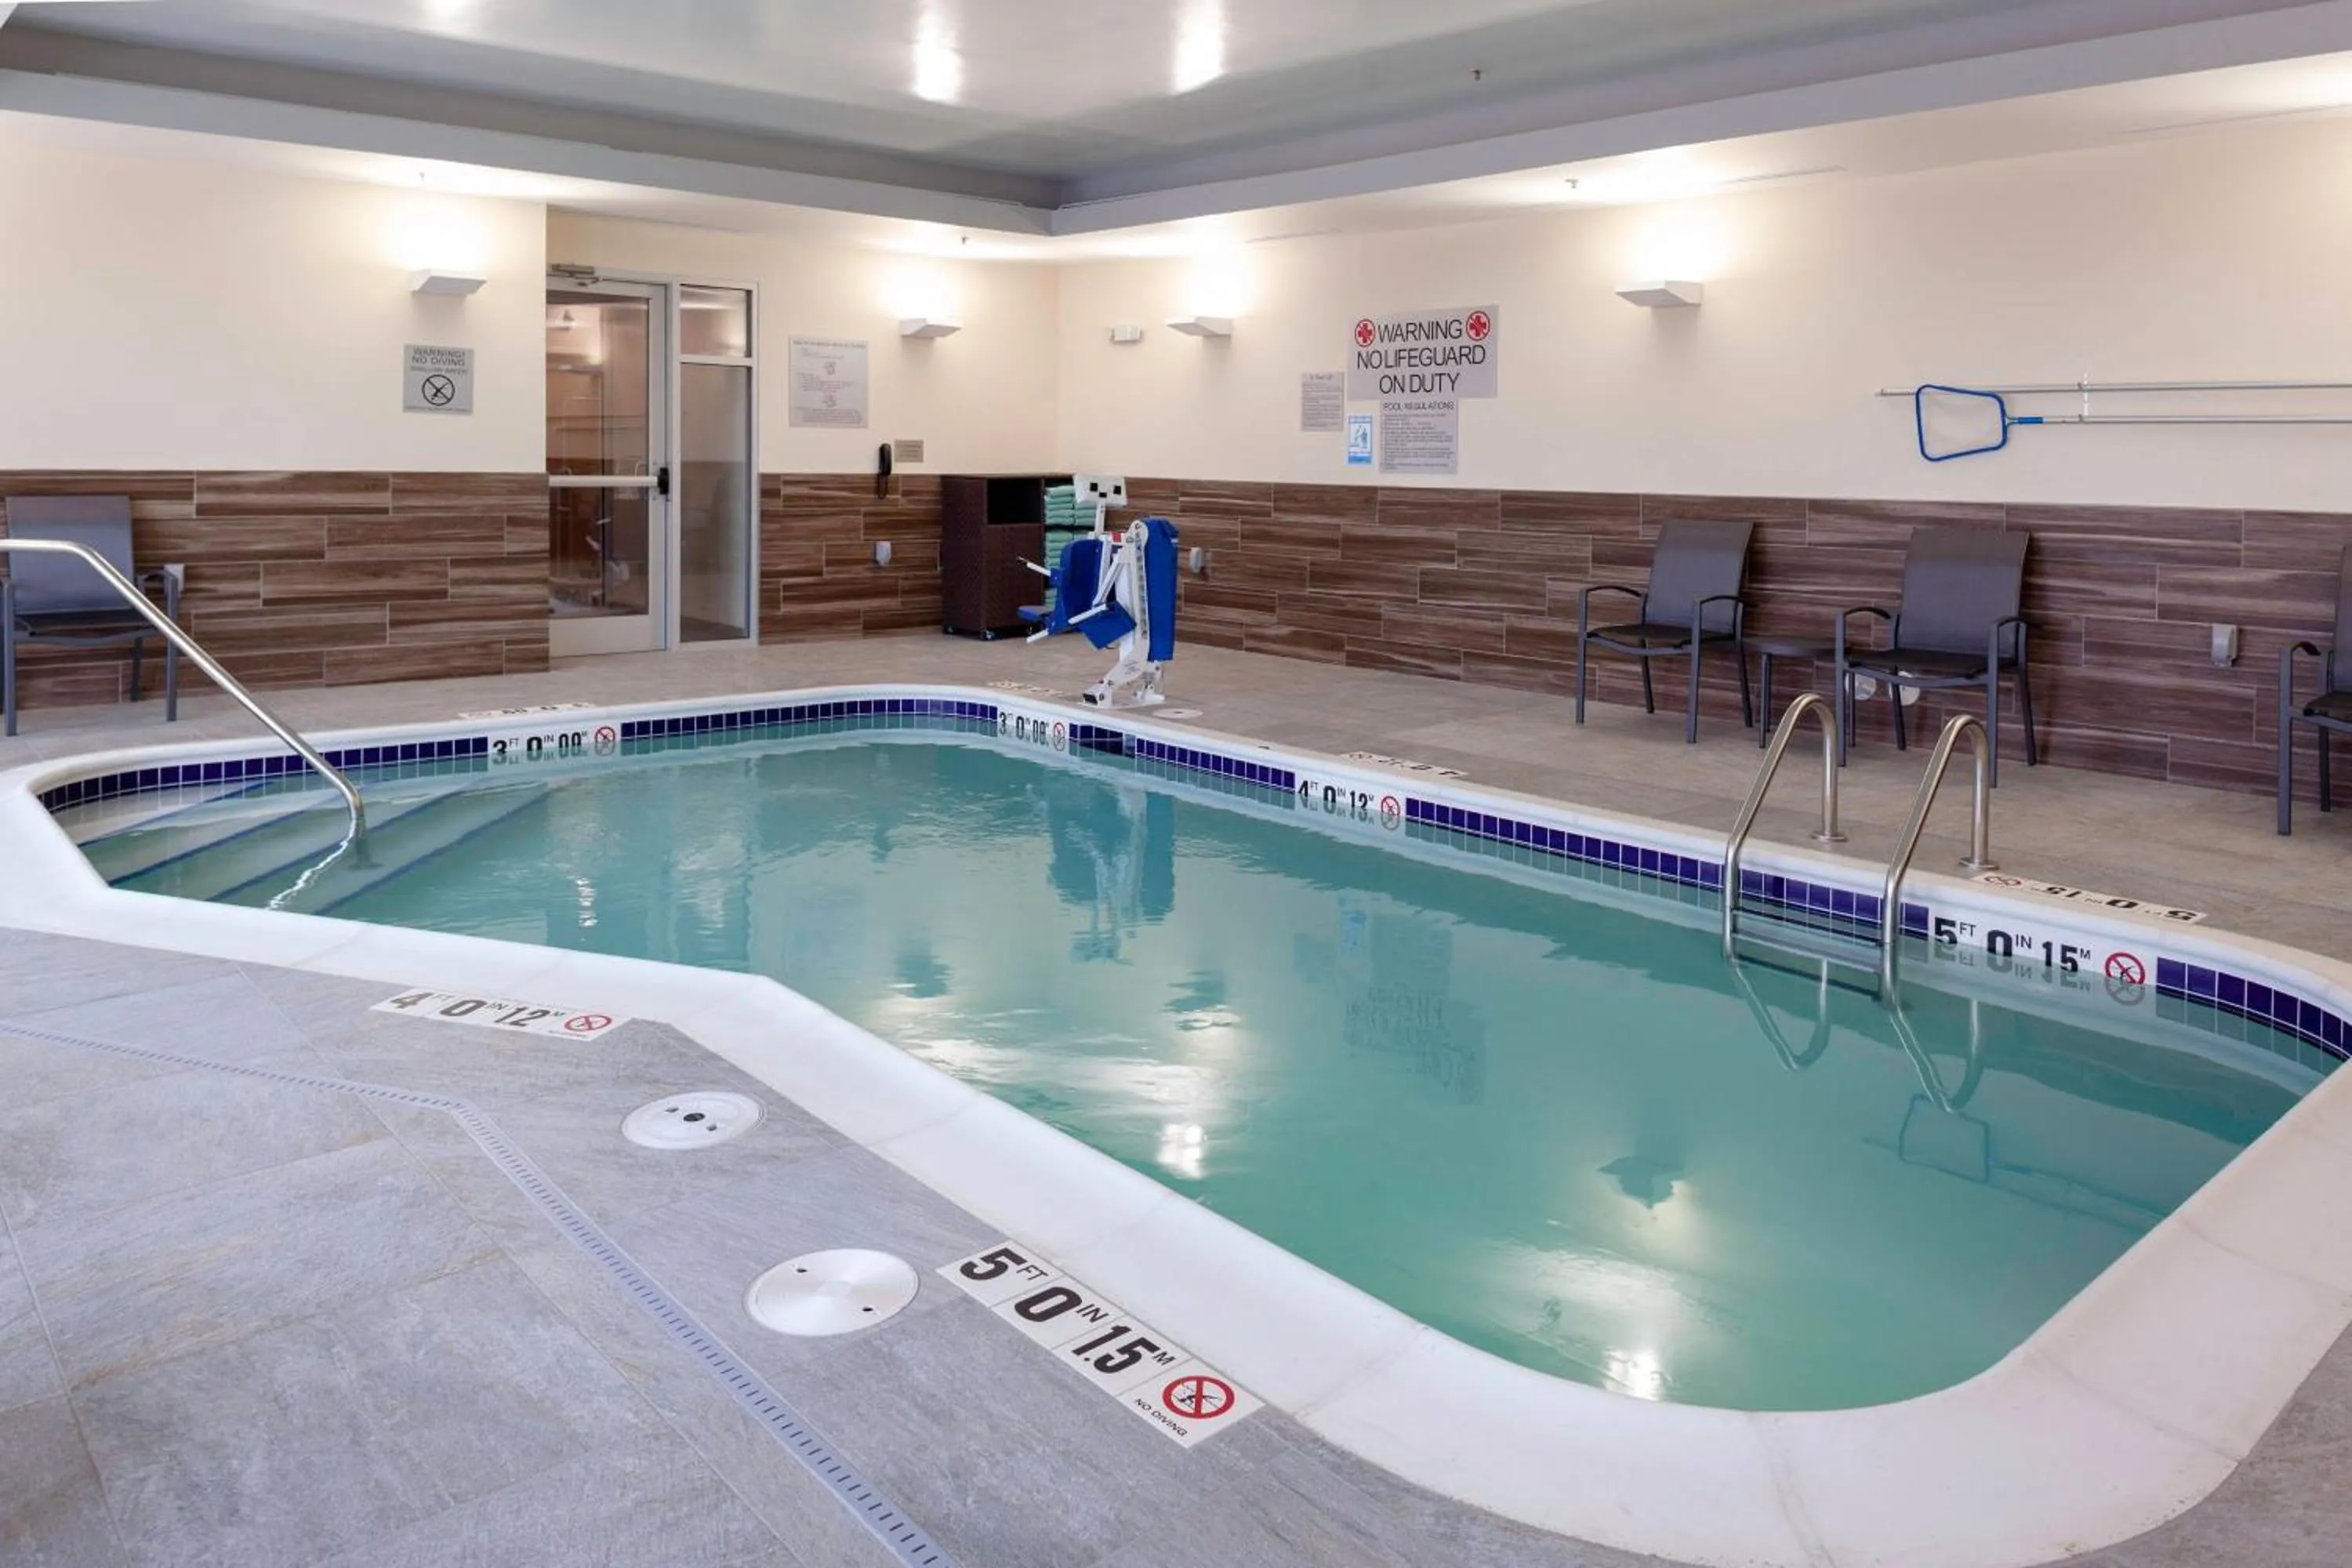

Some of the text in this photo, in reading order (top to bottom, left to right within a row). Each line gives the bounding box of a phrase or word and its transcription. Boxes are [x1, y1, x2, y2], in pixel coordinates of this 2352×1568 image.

[1378, 319, 1463, 343] WARNING
[412, 355, 465, 367] NO DIVING
[1357, 344, 1486, 369] NO LIFEGUARD
[1379, 372, 1461, 394] ON DUTY
[544, 734, 554, 744] IN
[1934, 916, 1958, 946] 5
[1959, 922, 1976, 938] FT
[1987, 929, 2013, 957] 0
[2016, 934, 2032, 949] IN
[2080, 949, 2091, 960] M
[390, 992, 435, 1010] 4
[439, 999, 488, 1017] 0
[960, 1247, 1027, 1281] 5
[1015, 1265, 1049, 1281] FT
[1014, 1286, 1083, 1323] 0
[1076, 1304, 1109, 1324] IN
[1152, 1351, 1176, 1367] M
[1134, 1399, 1188, 1436] NO DIVING
